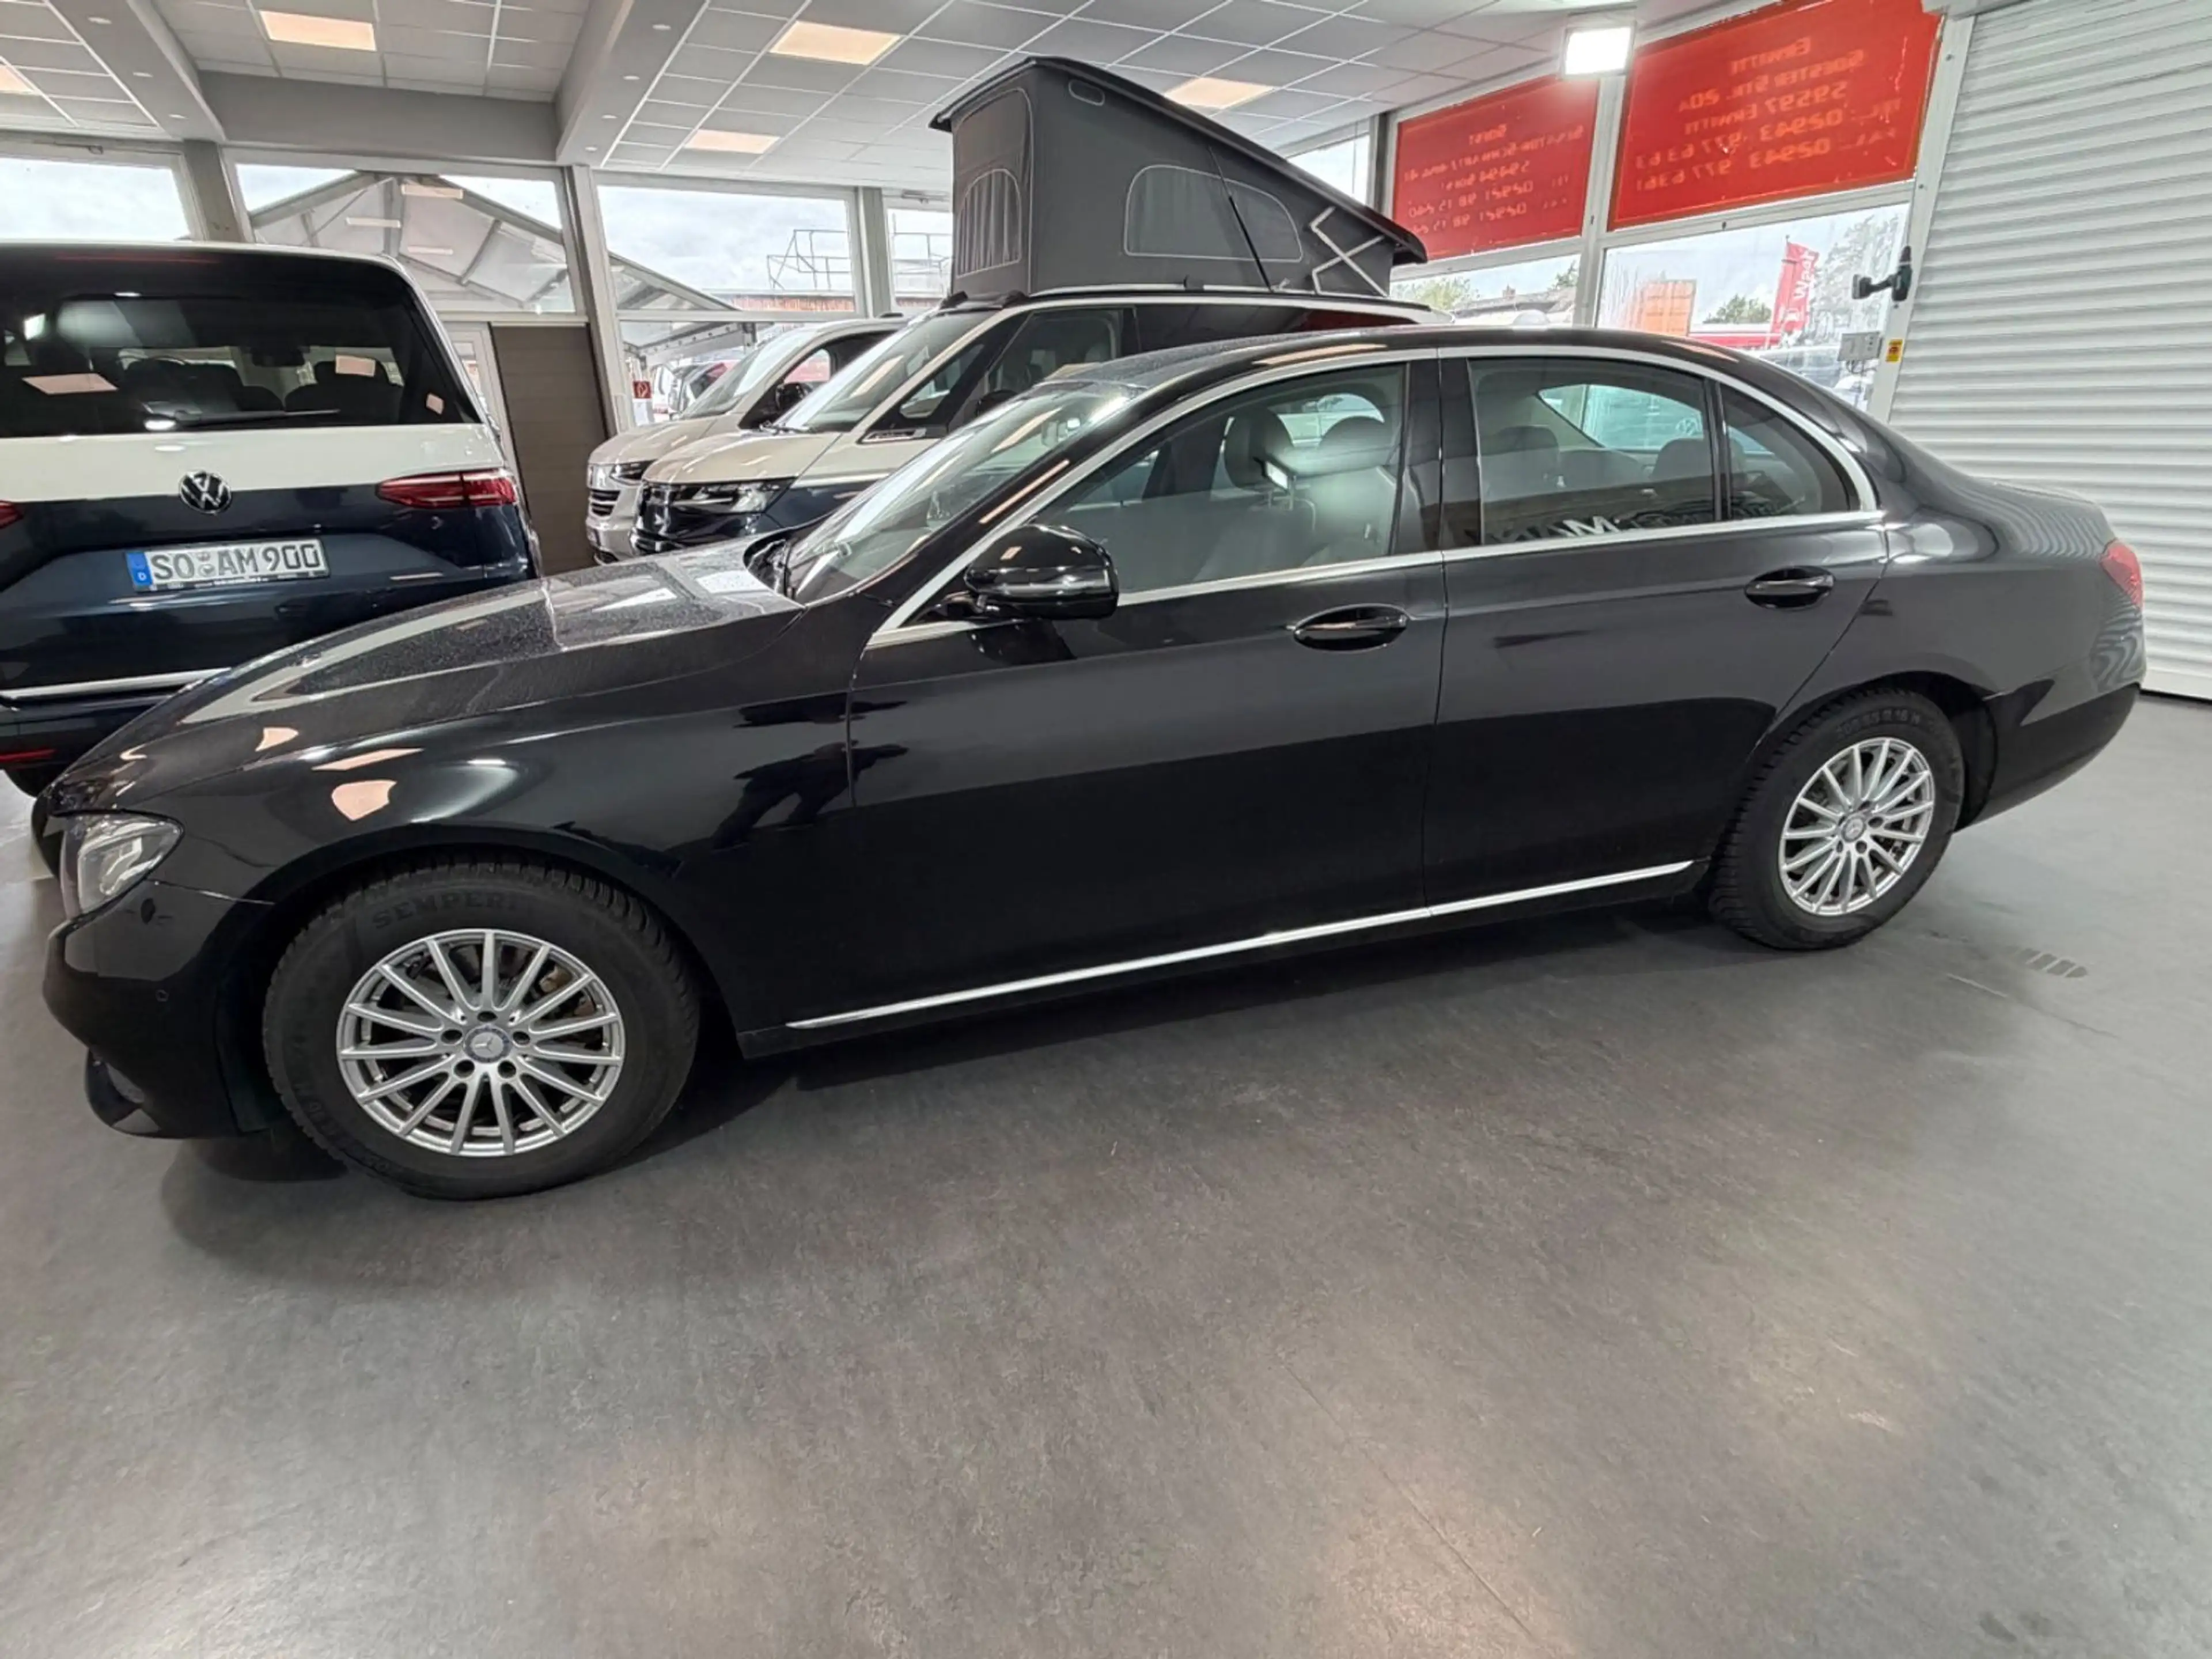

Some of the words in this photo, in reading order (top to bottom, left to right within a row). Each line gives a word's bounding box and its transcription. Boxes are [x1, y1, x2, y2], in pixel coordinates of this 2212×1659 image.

[150, 554, 195, 580] SO
[218, 548, 259, 576] AM
[262, 544, 320, 571] 900
